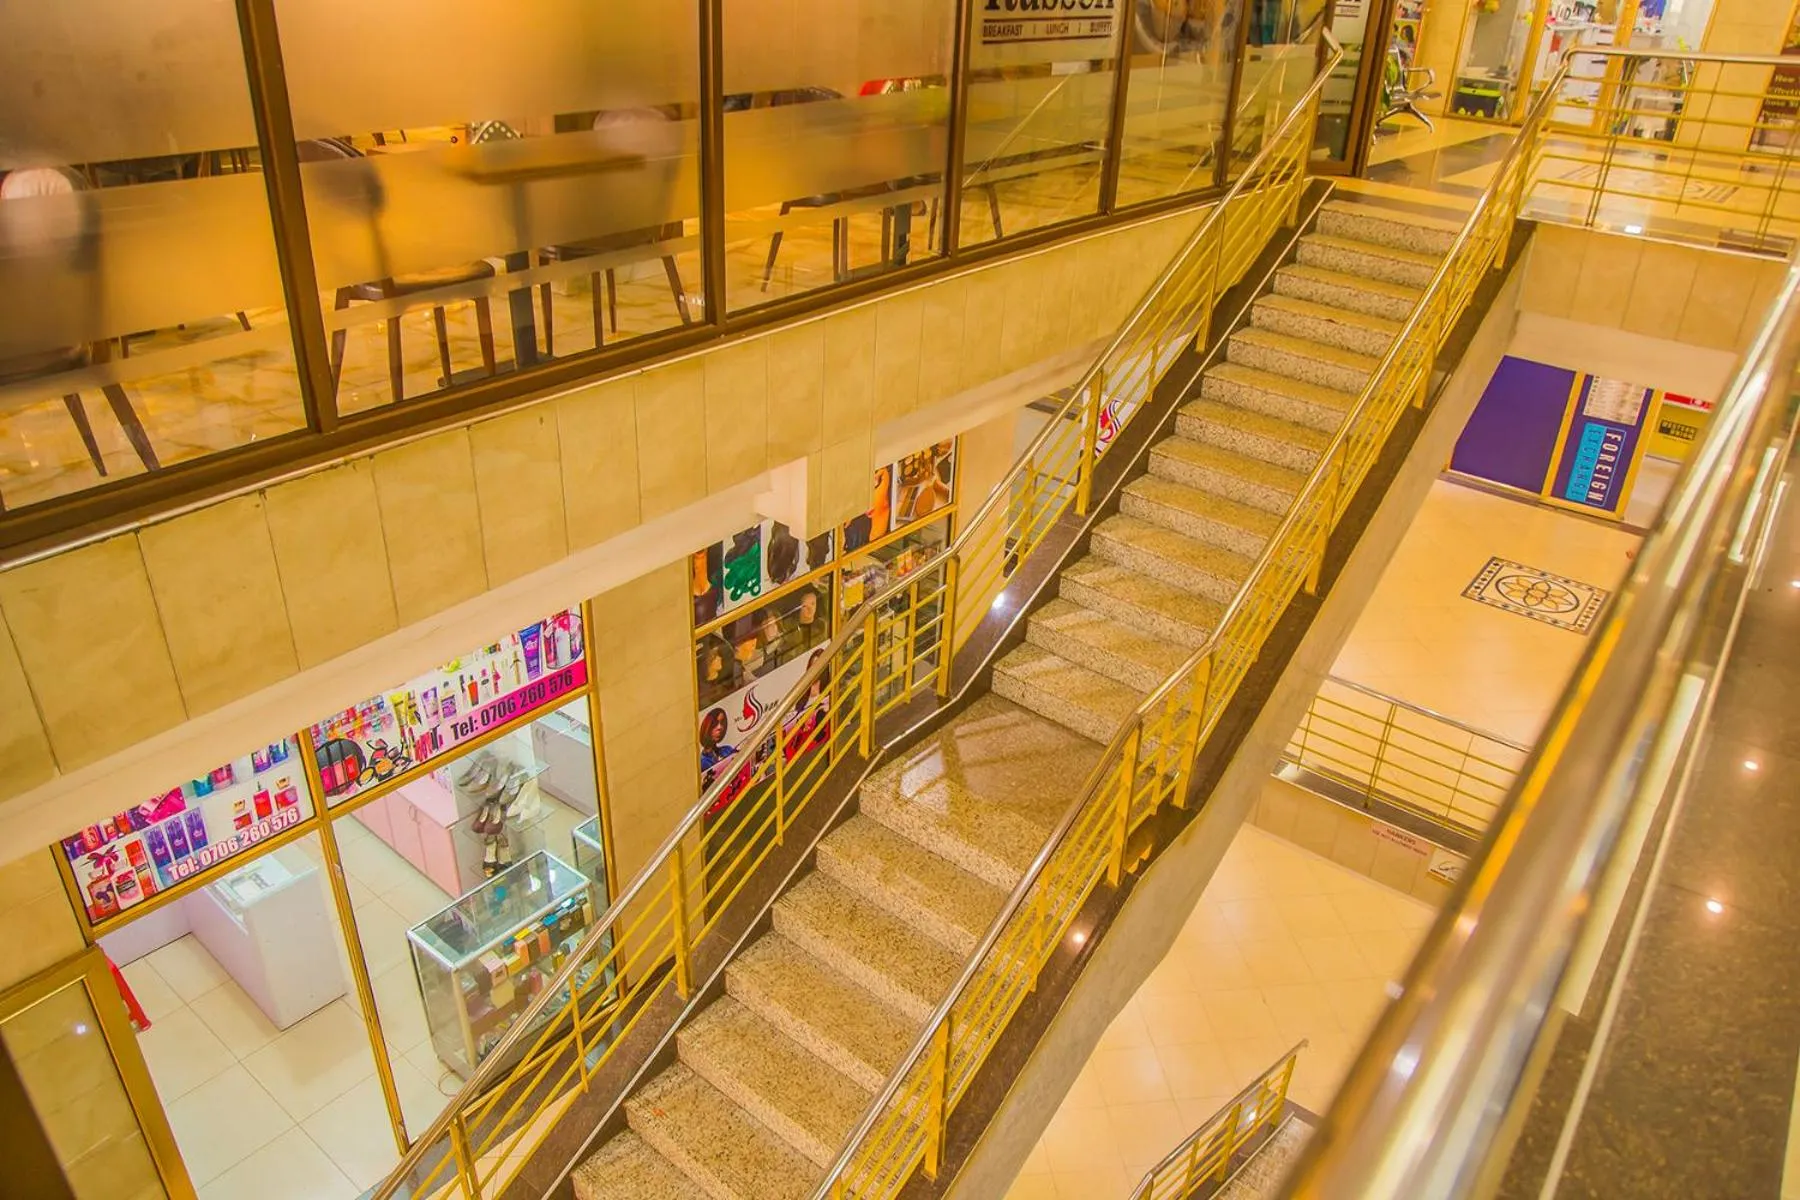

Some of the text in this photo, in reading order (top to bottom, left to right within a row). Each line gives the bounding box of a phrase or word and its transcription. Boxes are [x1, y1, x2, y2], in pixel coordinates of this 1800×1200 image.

[983, 24, 1024, 38] BREAKFAST
[1046, 22, 1069, 35] LUNCH
[1570, 428, 1601, 497] EXCHANGE
[1587, 432, 1622, 502] FOREIGN
[450, 669, 574, 741] Tel: 0706 260 576
[168, 856, 200, 881] Tel:
[199, 837, 239, 867] 0706
[240, 822, 271, 847] 260
[271, 807, 299, 831] 576
